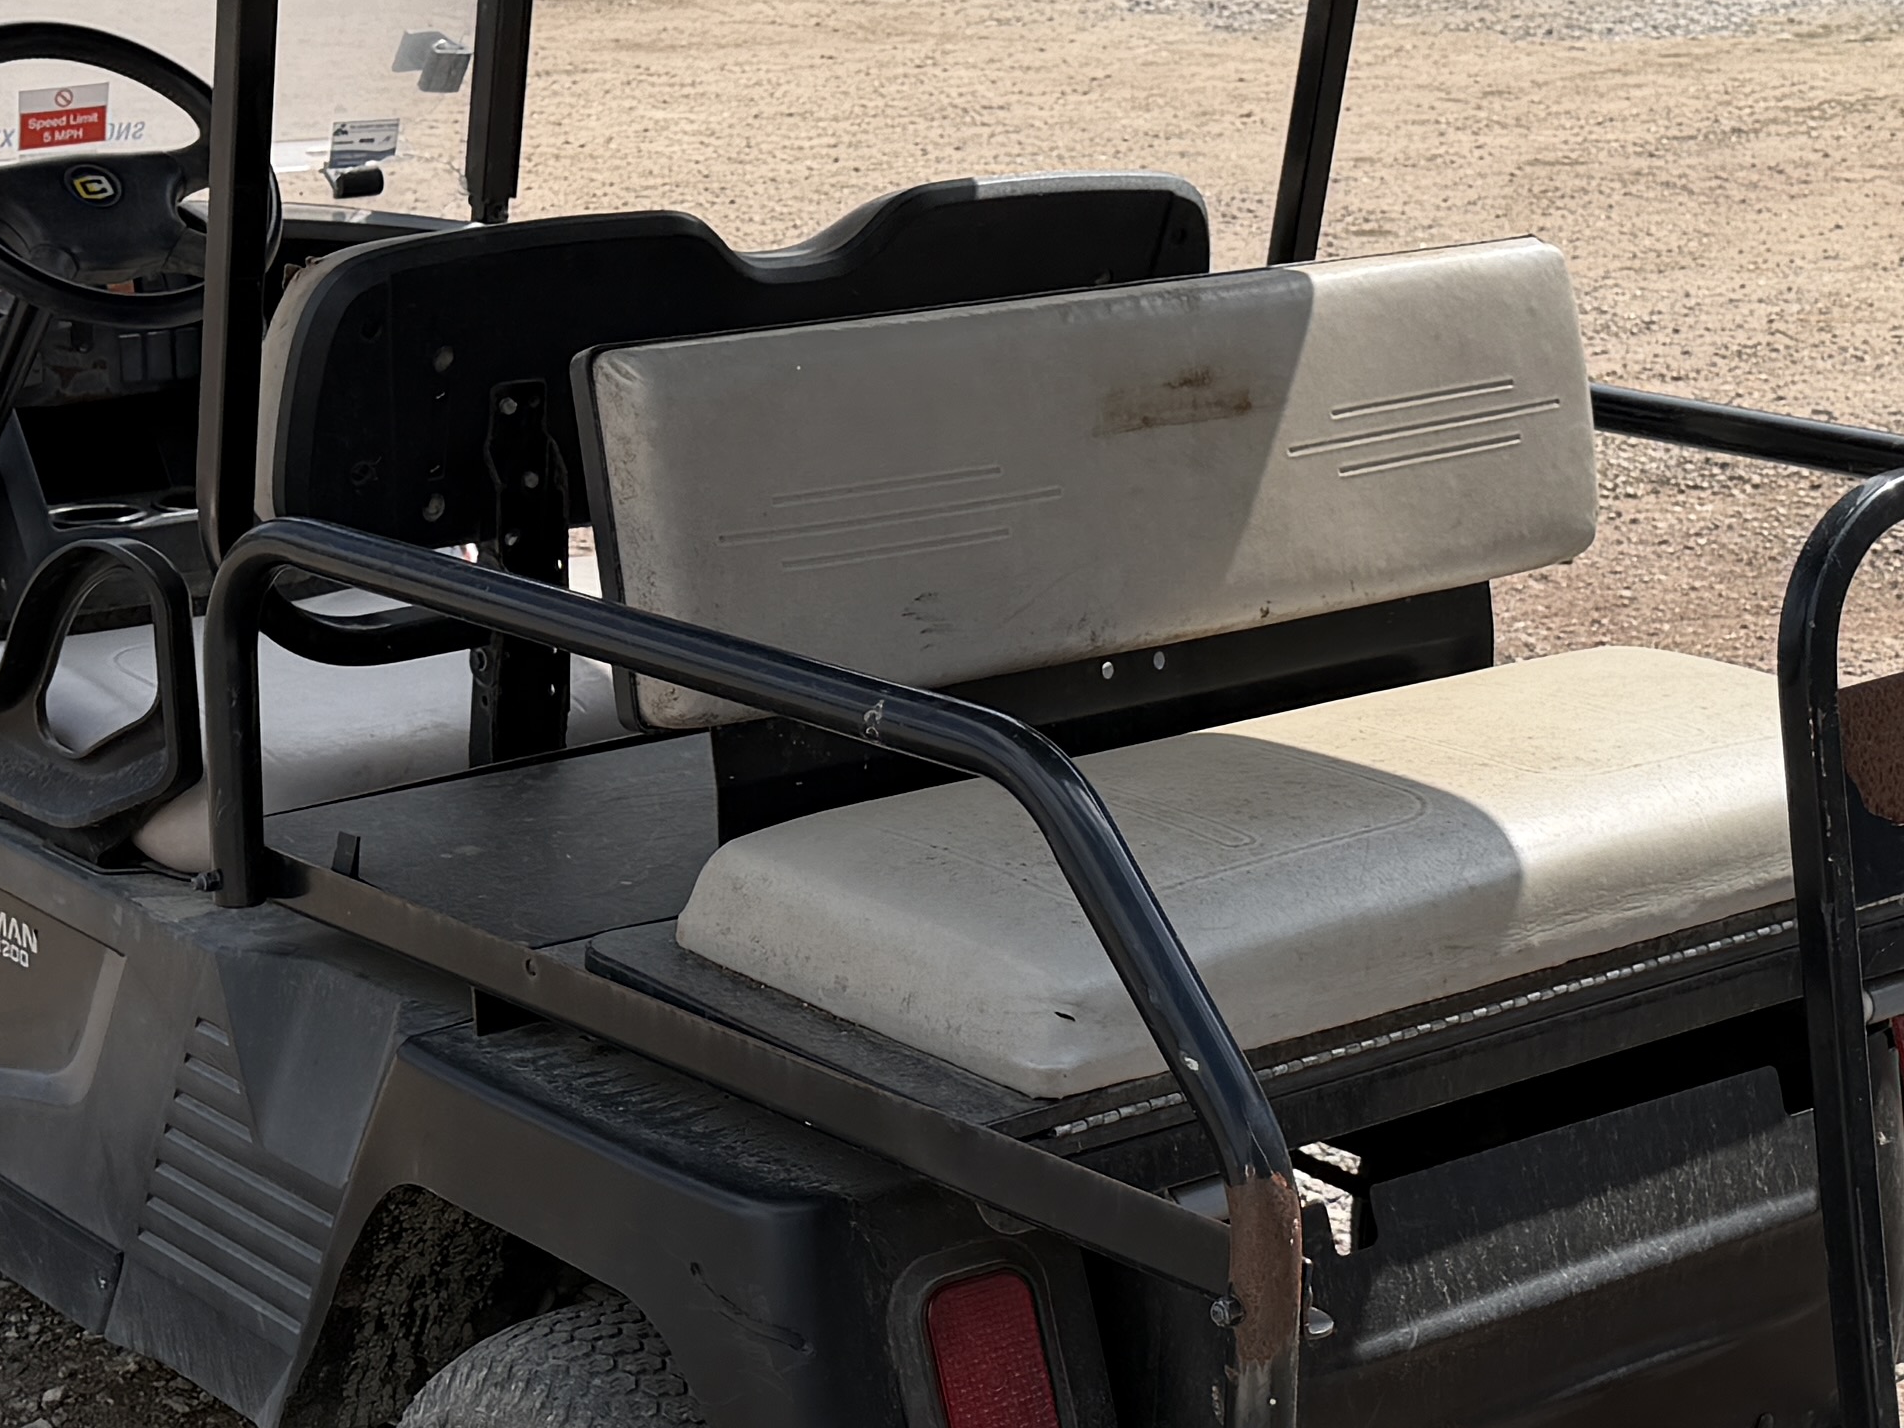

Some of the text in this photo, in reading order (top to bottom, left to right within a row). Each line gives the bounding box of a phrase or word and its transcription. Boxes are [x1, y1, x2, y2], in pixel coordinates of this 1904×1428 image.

[28, 112, 98, 130] Speed Limit
[54, 128, 83, 142] MPH
